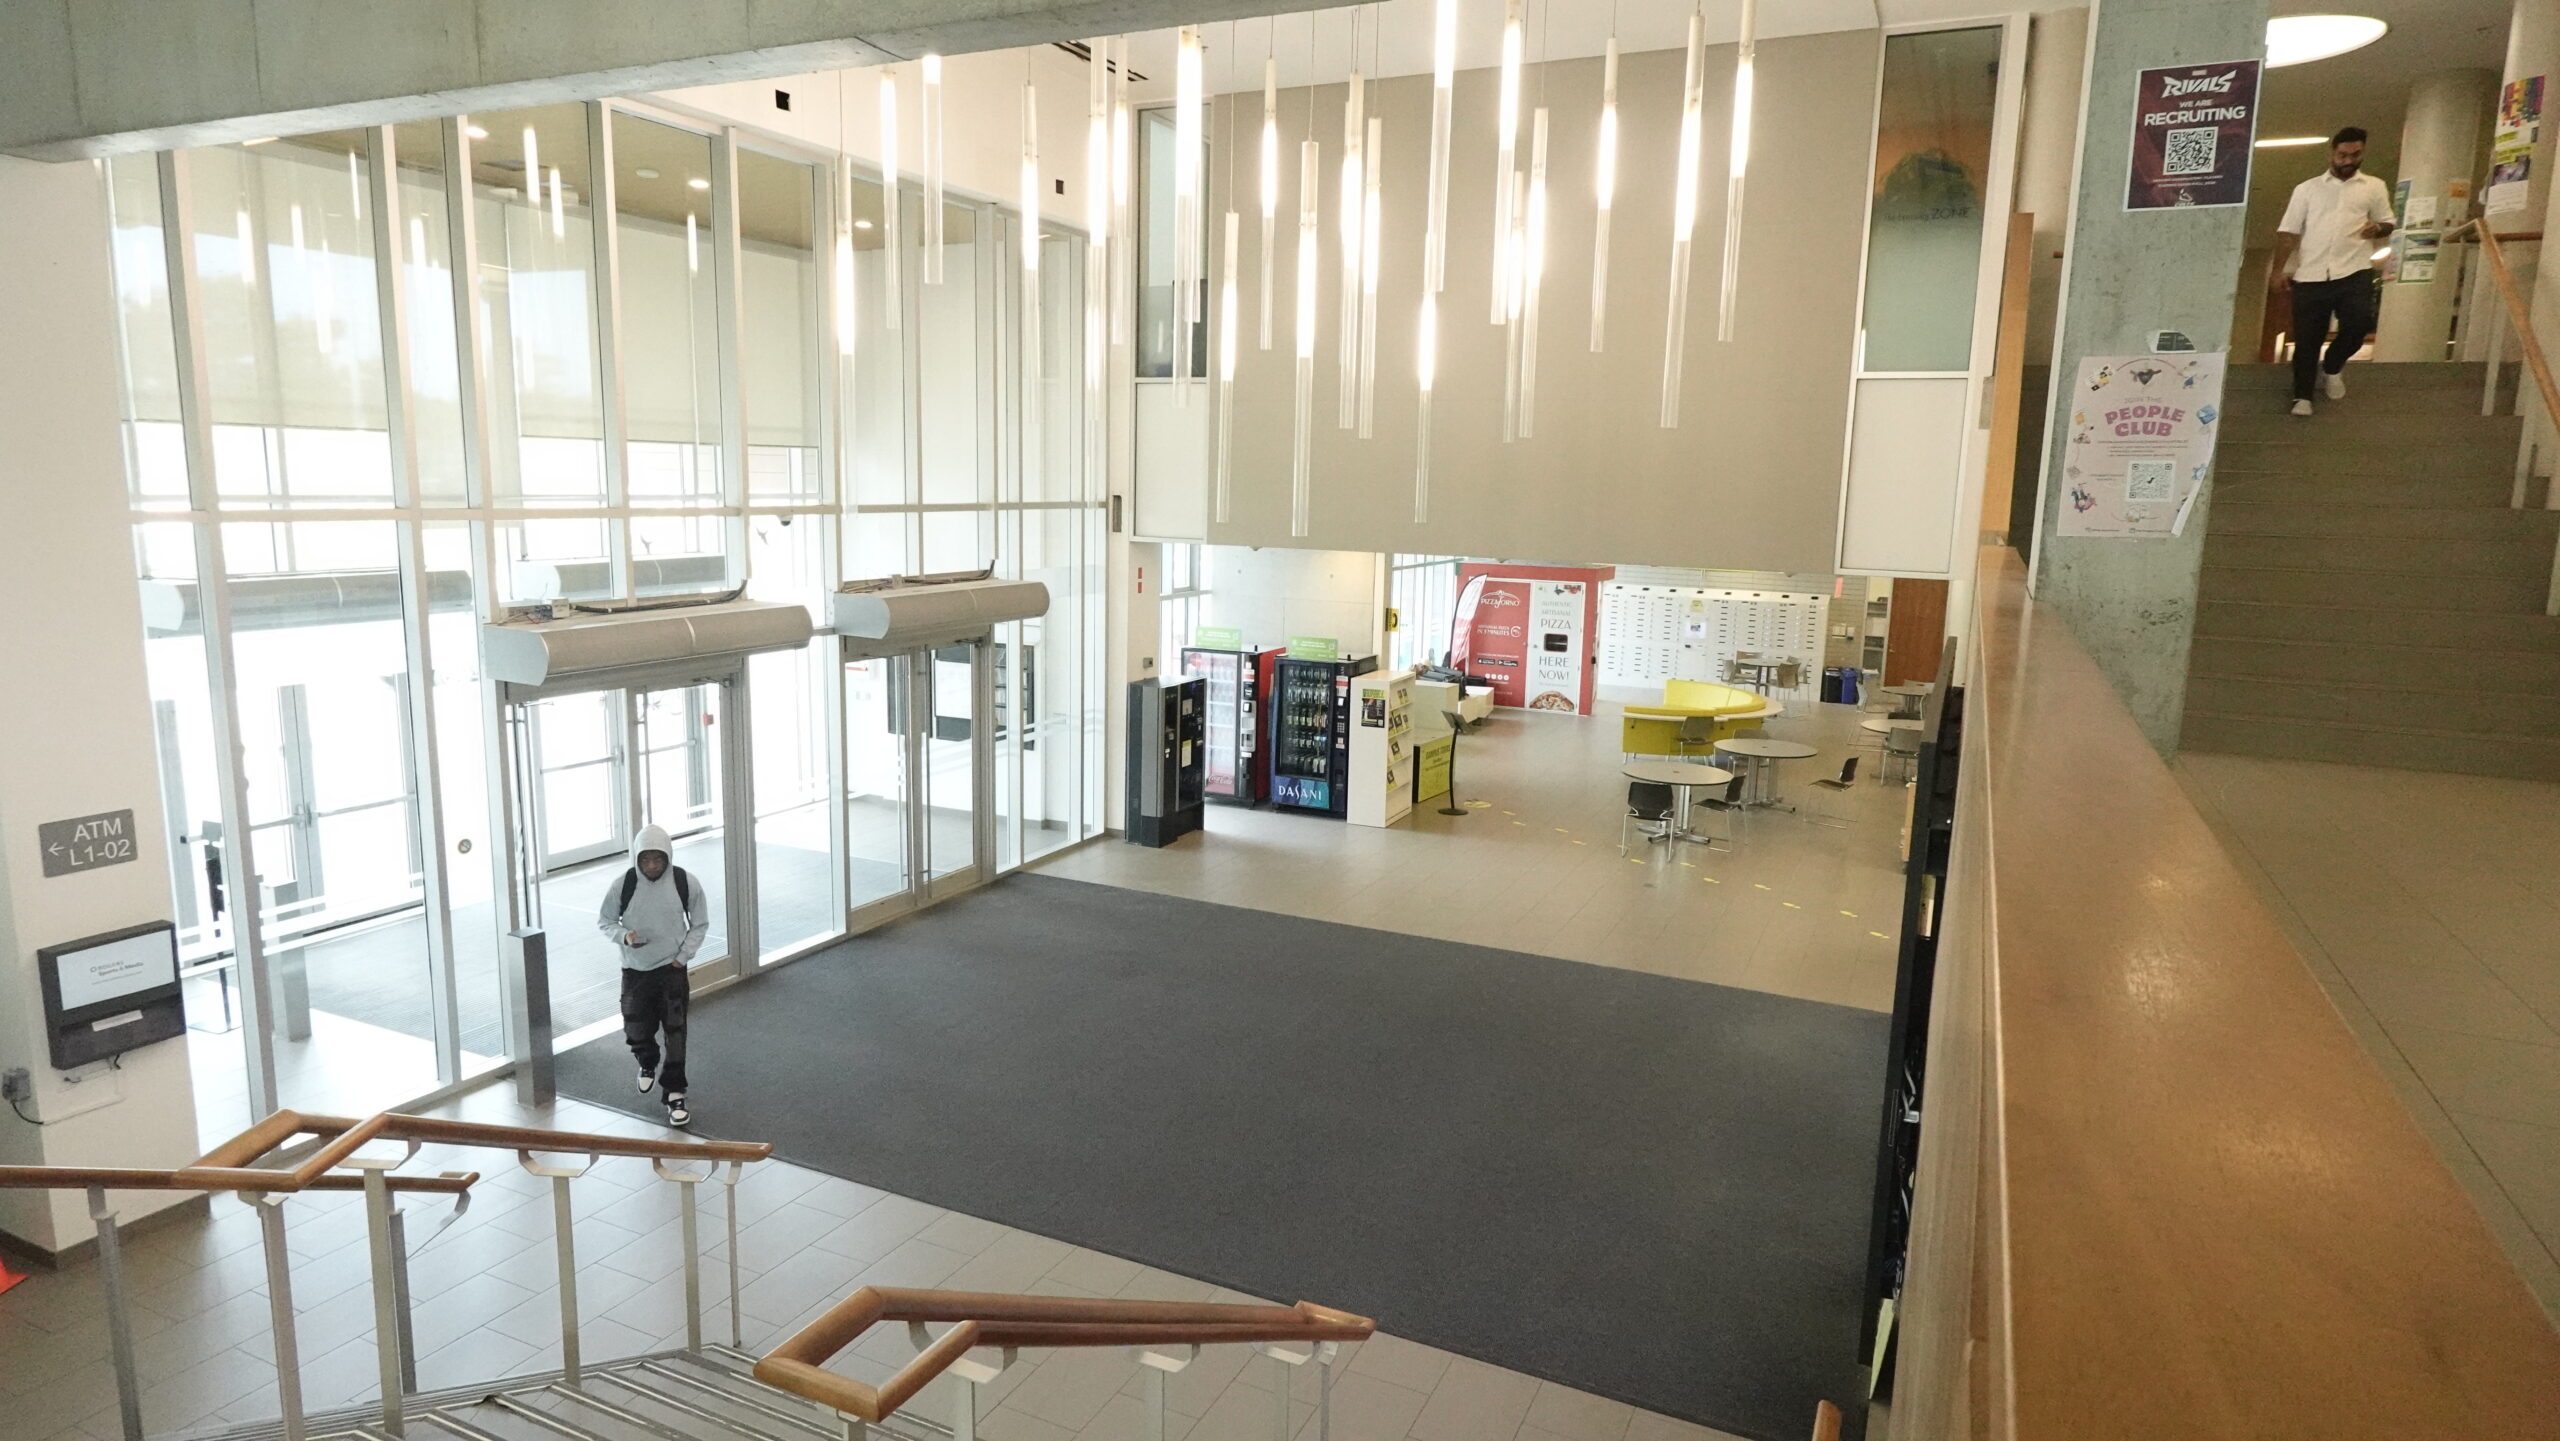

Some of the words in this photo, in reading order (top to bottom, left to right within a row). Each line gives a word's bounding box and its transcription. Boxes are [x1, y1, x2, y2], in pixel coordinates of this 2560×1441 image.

[2161, 69, 2237, 98] RIVALS
[2195, 99, 2213, 107] ARE
[2144, 105, 2246, 126] RECRUITING
[2105, 405, 2186, 425] PEOPLE
[2115, 421, 2173, 437] CLUB
[1540, 618, 1571, 630] PIZZA
[1539, 655, 1569, 667] HERE
[1539, 669, 1569, 680] NOW!
[1278, 785, 1322, 801] DASANI
[74, 817, 122, 842] ATM
[70, 838, 131, 866] L1-02
